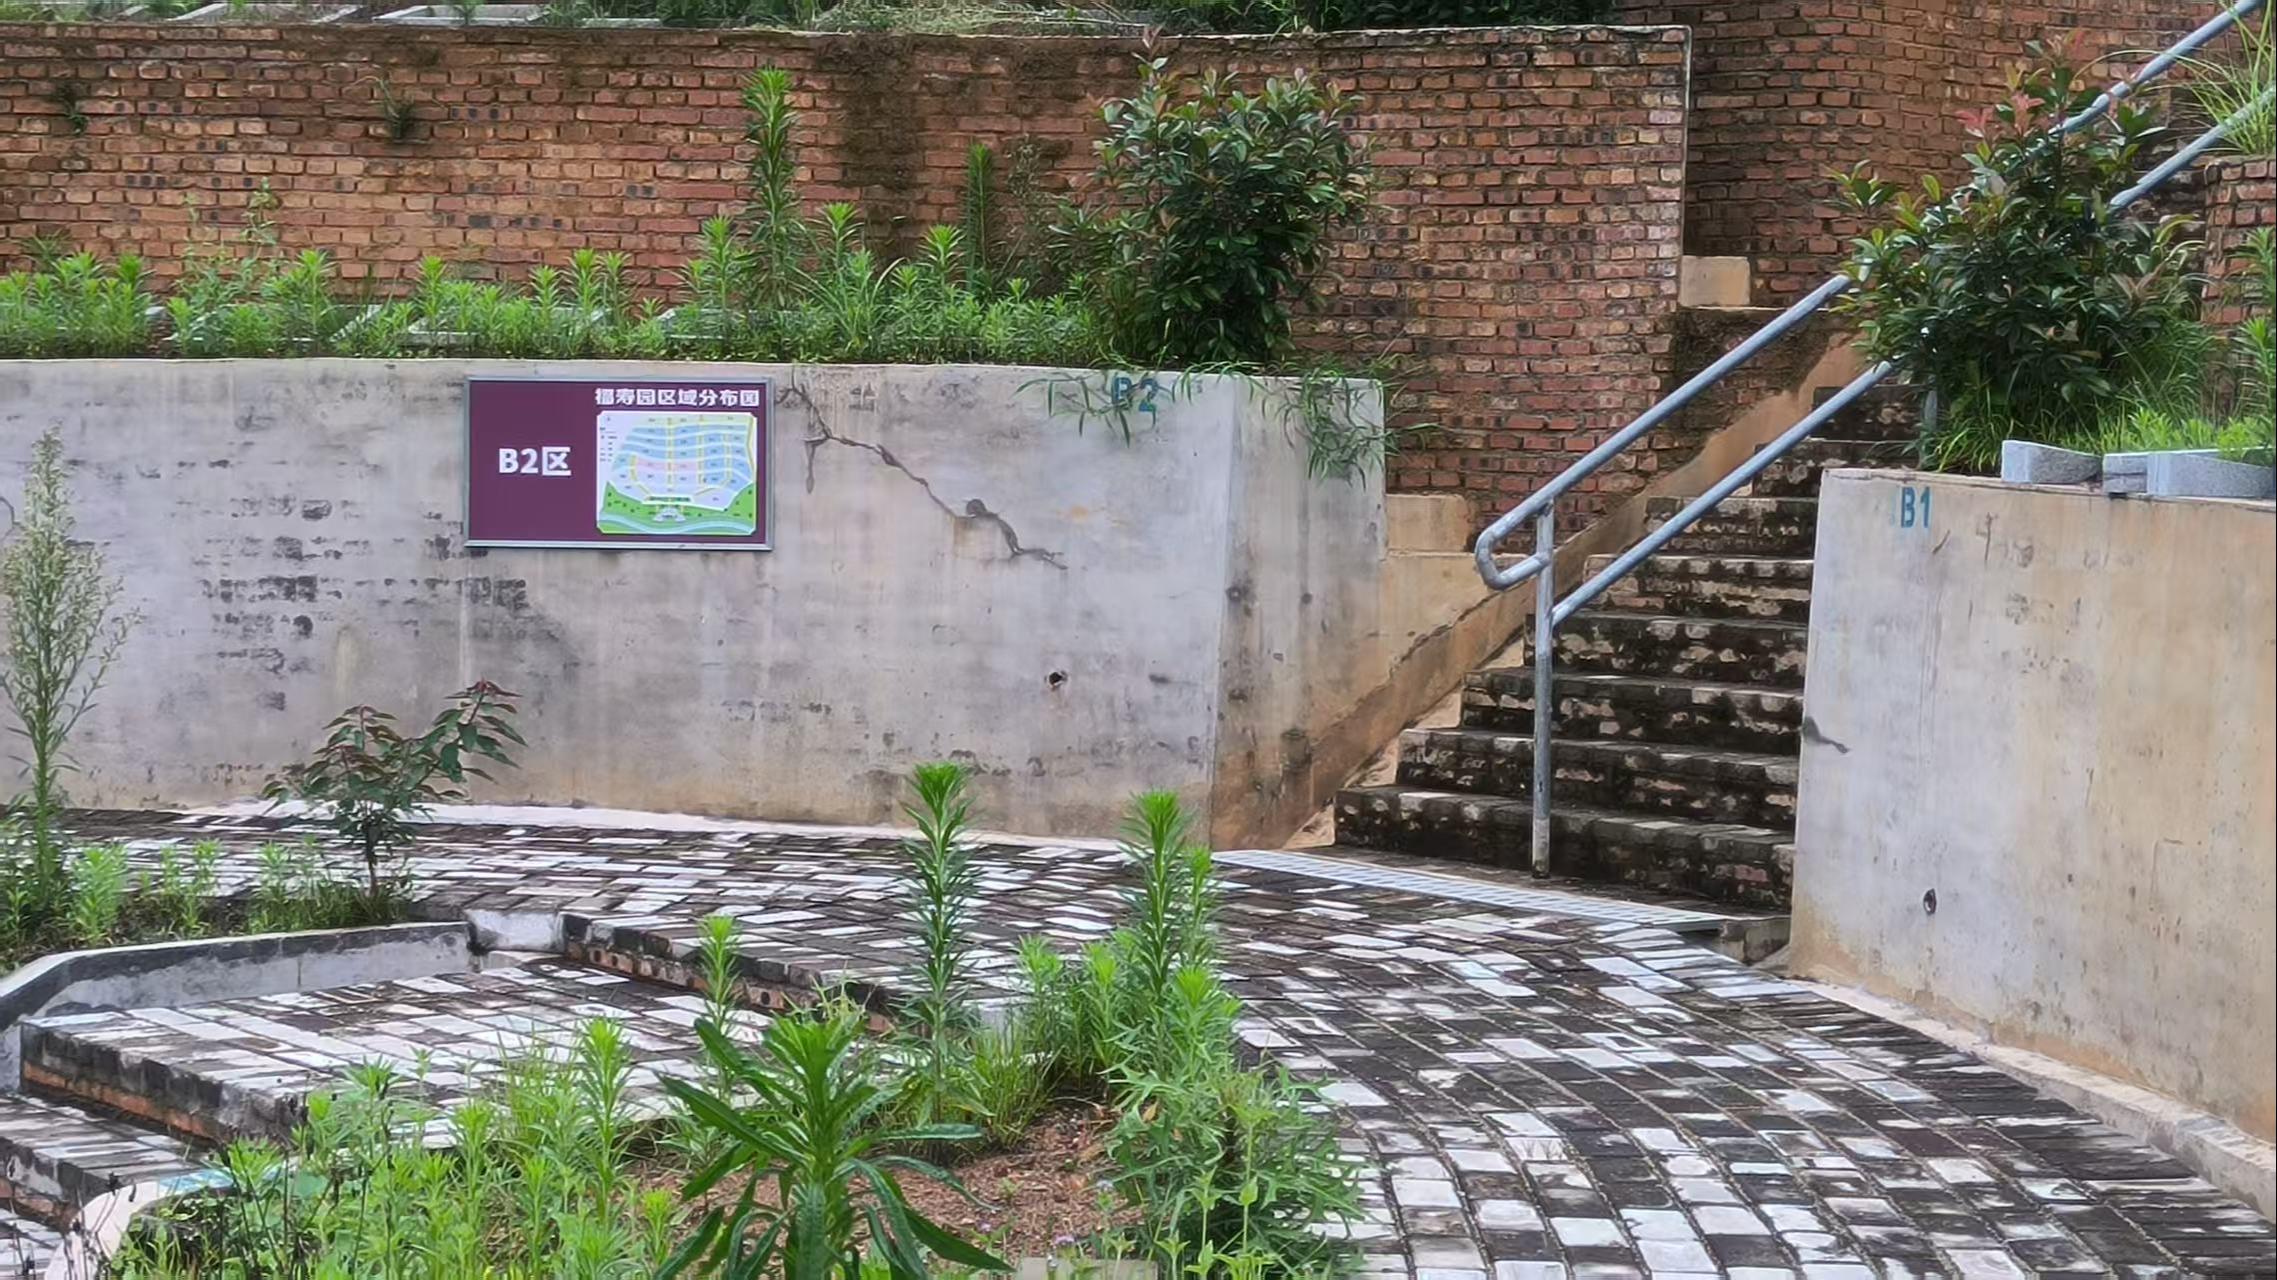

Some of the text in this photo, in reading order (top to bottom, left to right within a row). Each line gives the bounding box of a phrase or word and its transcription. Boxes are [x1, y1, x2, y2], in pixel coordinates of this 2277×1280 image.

[595, 387, 760, 407] 福寿园区域分布图
[498, 446, 572, 476] B2区
[1900, 486, 1931, 528] B1
